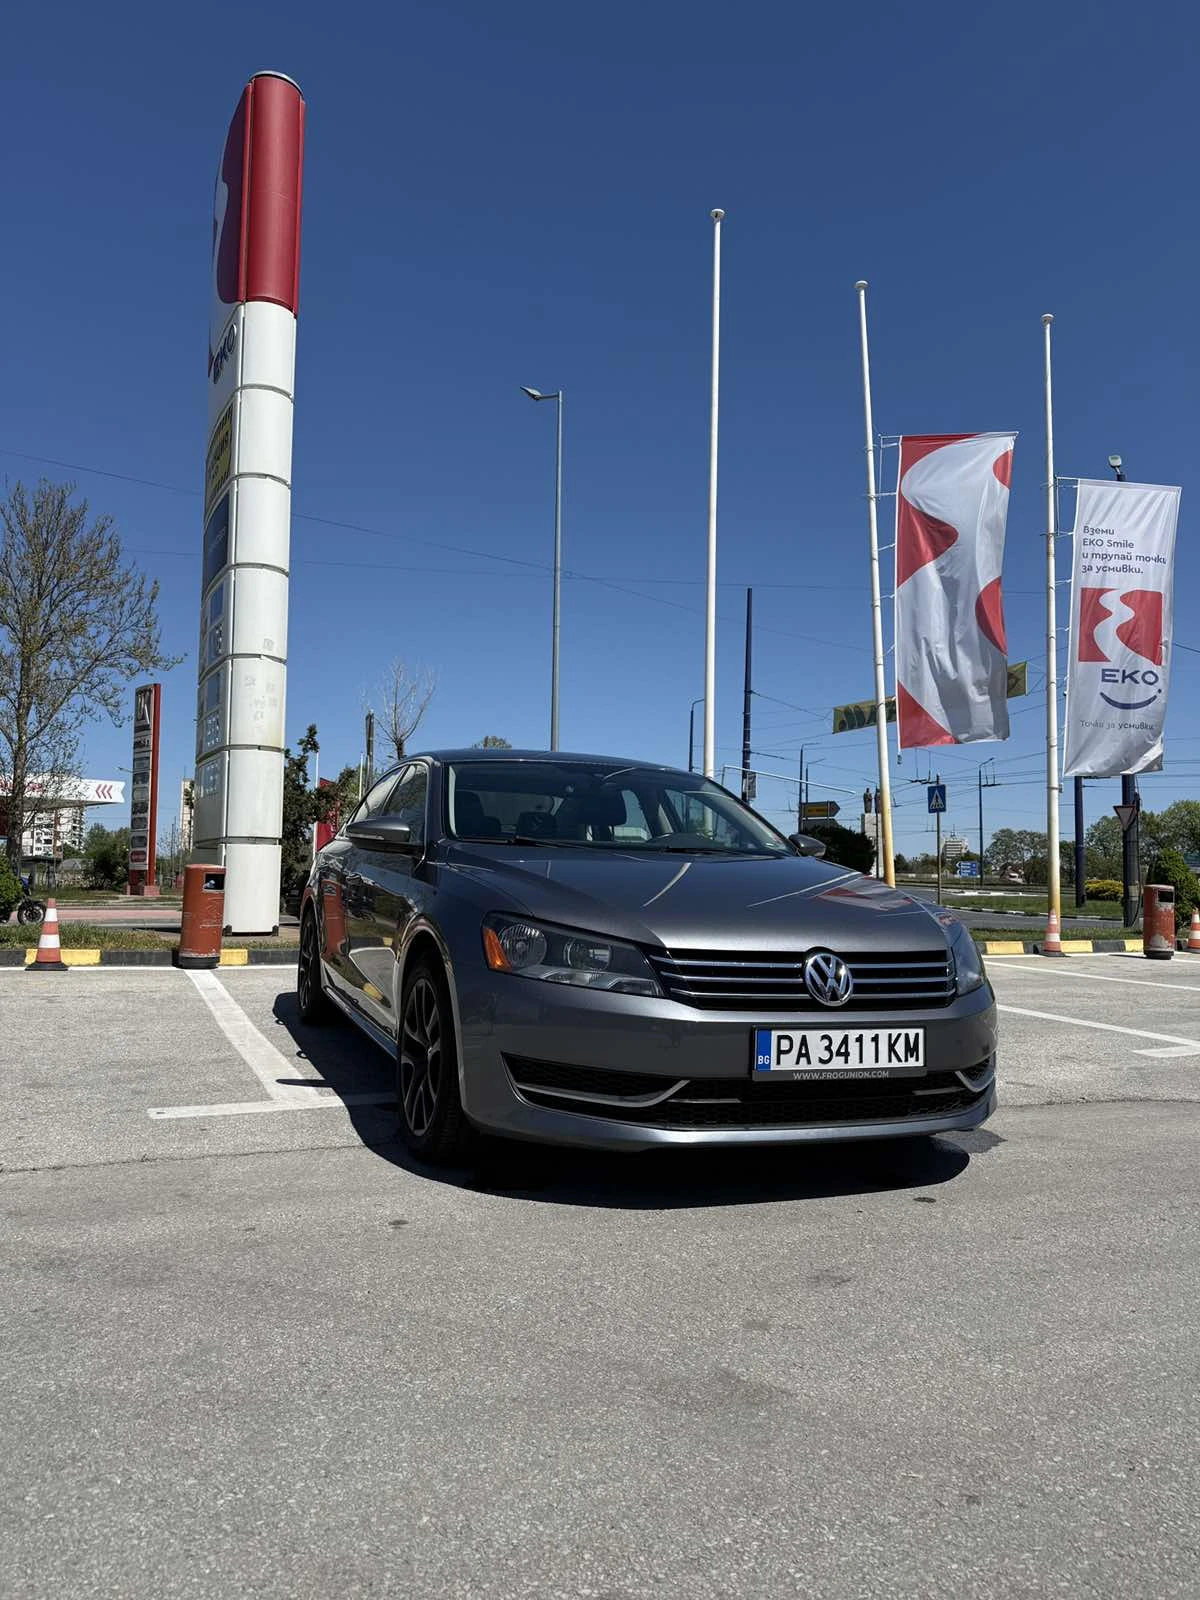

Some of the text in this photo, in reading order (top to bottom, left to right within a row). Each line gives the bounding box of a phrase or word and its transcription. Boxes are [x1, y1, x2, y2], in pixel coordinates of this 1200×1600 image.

[1083, 525, 1115, 536] Вземи
[1082, 538, 1135, 549] EKO Smile
[1091, 551, 1133, 562] трупай
[1081, 564, 1144, 575] за усмивки.
[1101, 668, 1159, 686] EKO
[757, 1055, 770, 1065] BG
[793, 1070, 889, 1080] WWW.FROGUNION.COM
